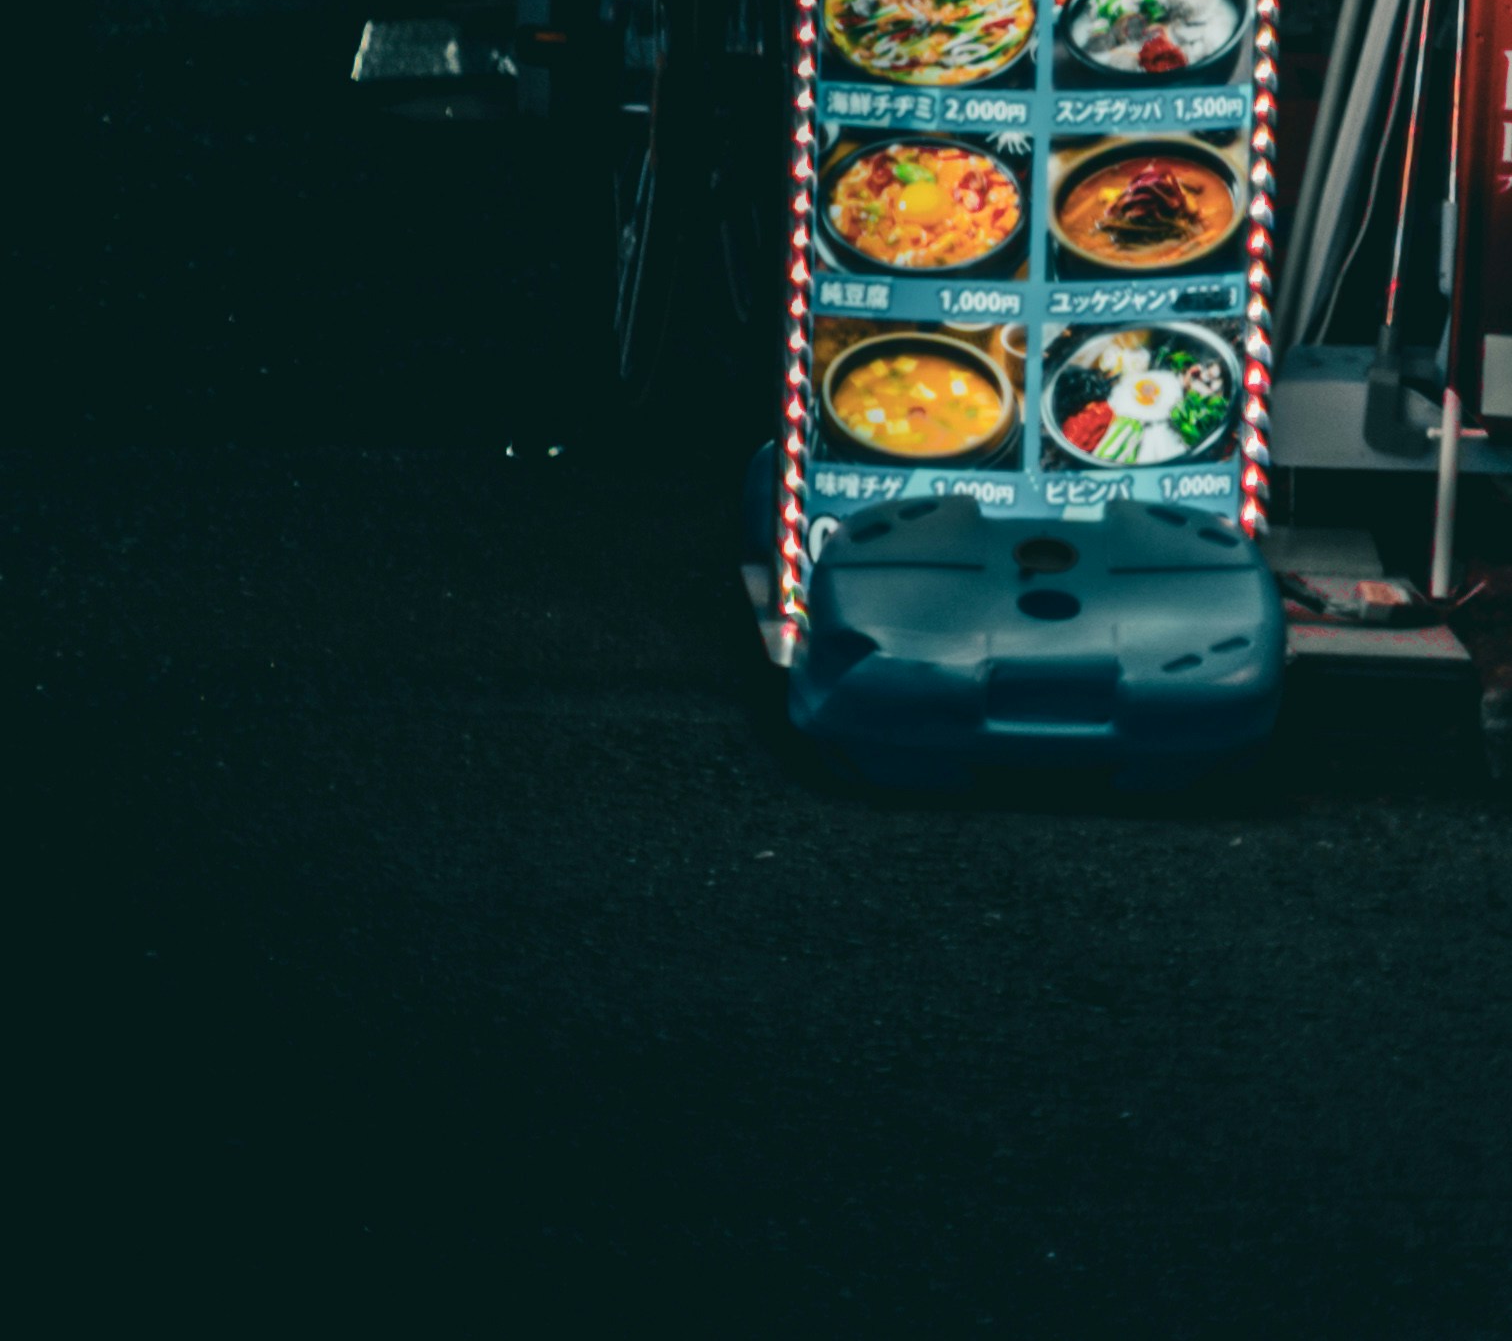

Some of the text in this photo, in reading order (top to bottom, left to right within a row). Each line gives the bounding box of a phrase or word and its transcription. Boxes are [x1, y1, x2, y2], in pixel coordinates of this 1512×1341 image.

[943, 98, 1028, 124] 2,000円
[1173, 96, 1245, 120] 1,500円
[938, 287, 1022, 314] 1,000円
[1160, 472, 1232, 499] 1,000円
